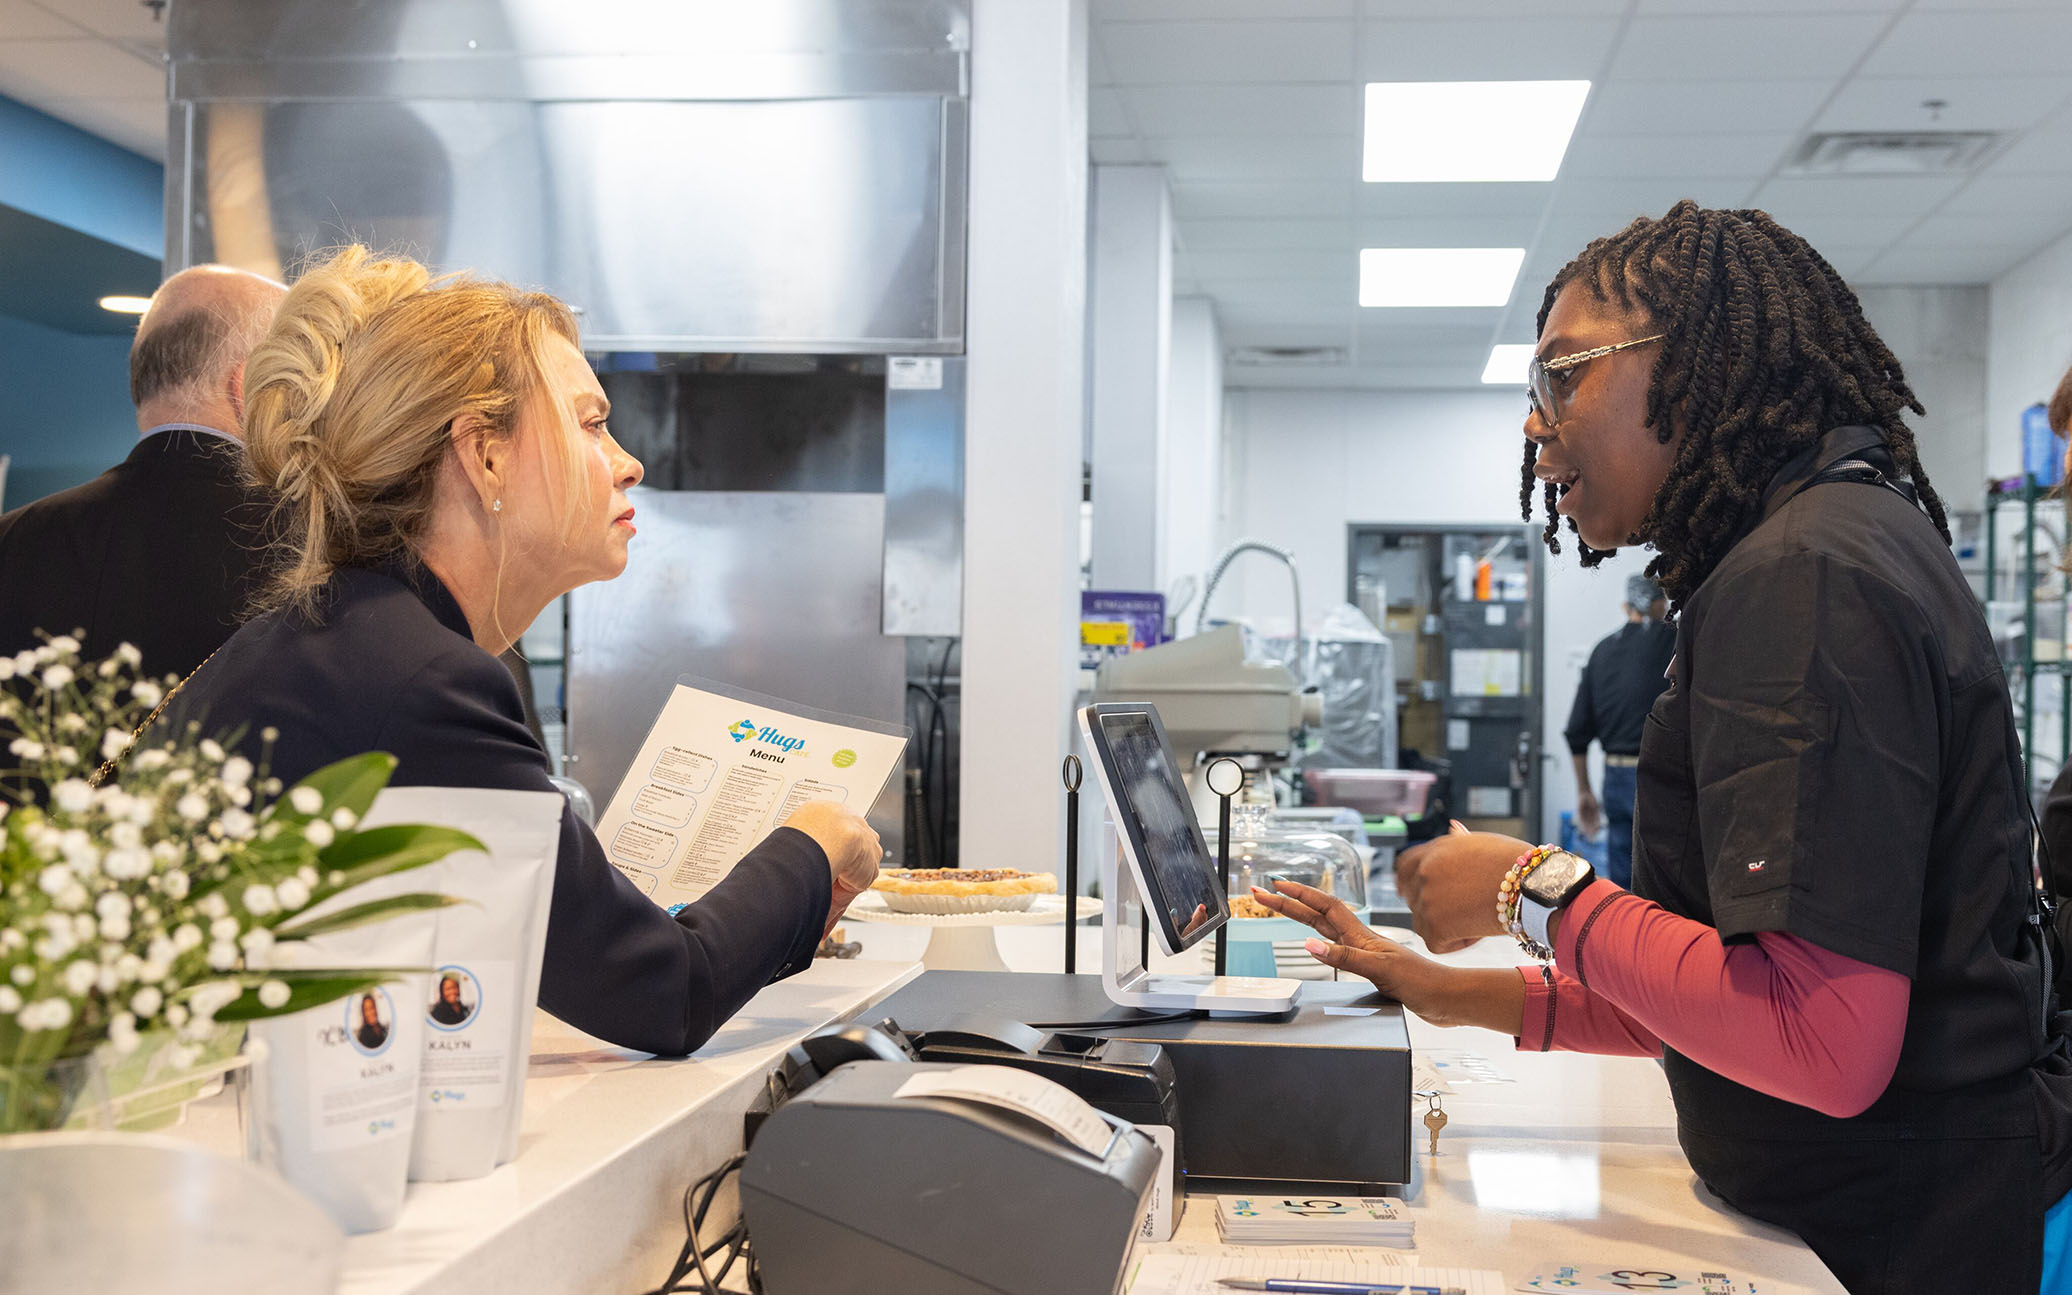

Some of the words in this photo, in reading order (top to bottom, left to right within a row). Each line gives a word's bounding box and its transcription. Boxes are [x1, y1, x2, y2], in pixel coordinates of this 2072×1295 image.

[757, 726, 805, 752] Hugs
[698, 752, 713, 761] Dishes
[749, 748, 786, 764] Menu
[741, 764, 767, 773] Sandwiches
[651, 783, 673, 794] Breakfast
[672, 789, 685, 797] Sides
[646, 824, 664, 834] Sweeter
[630, 866, 642, 874] Sides
[429, 1039, 471, 1051] KALYN
[1283, 1199, 1347, 1217] 15
[1611, 1270, 1677, 1289] 13
